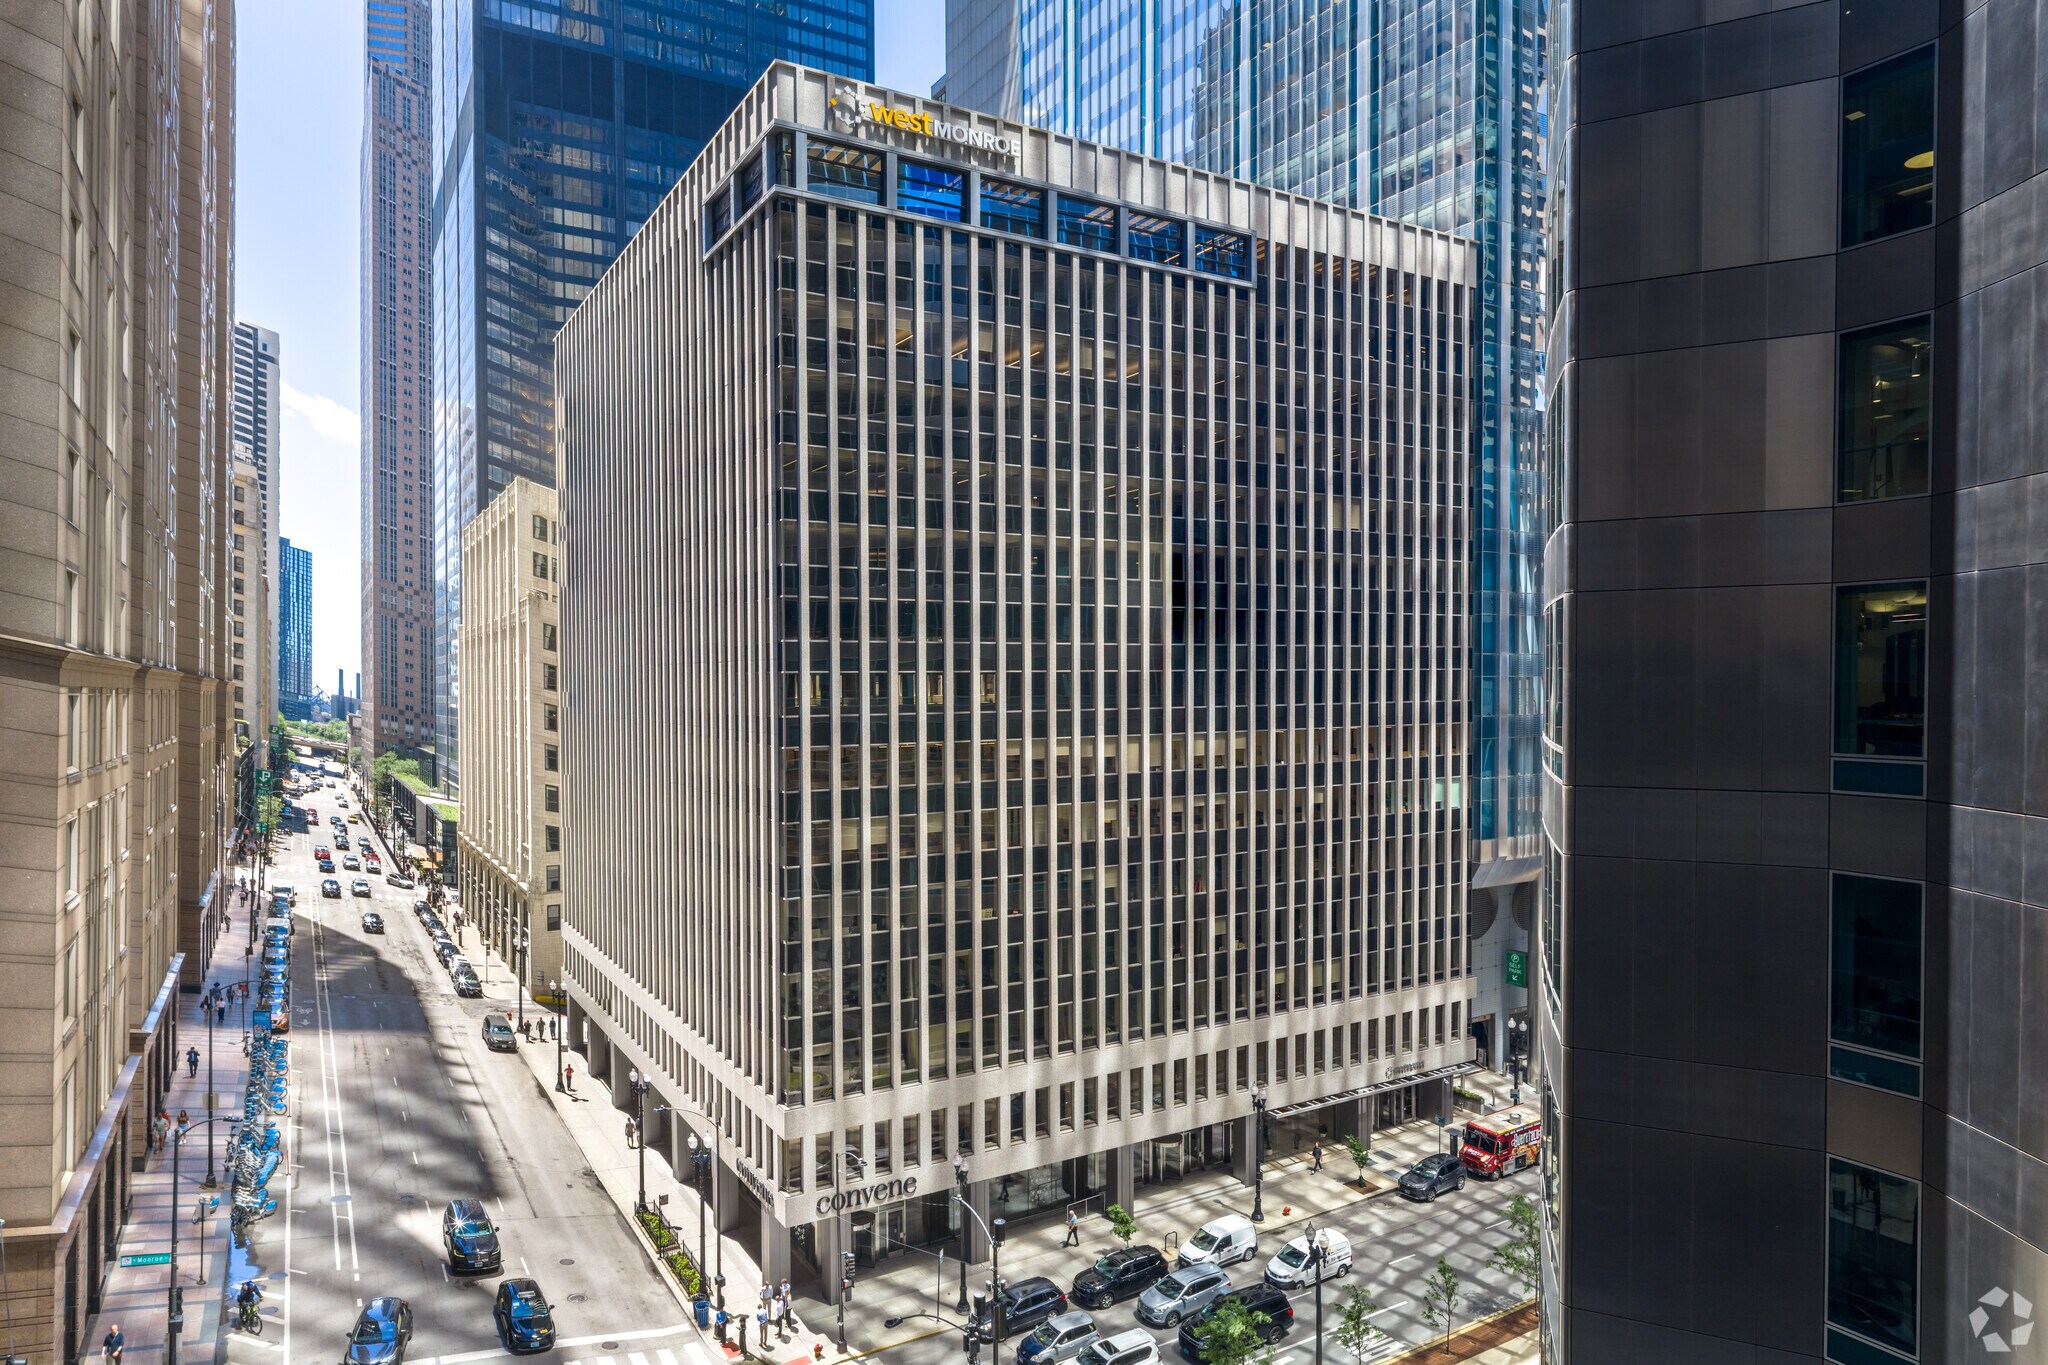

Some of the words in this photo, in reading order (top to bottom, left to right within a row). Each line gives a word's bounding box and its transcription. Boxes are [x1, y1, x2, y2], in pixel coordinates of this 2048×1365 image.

[1508, 961, 1521, 969] SELF
[1508, 967, 1522, 975] PARK
[816, 1176, 917, 1214] convene
